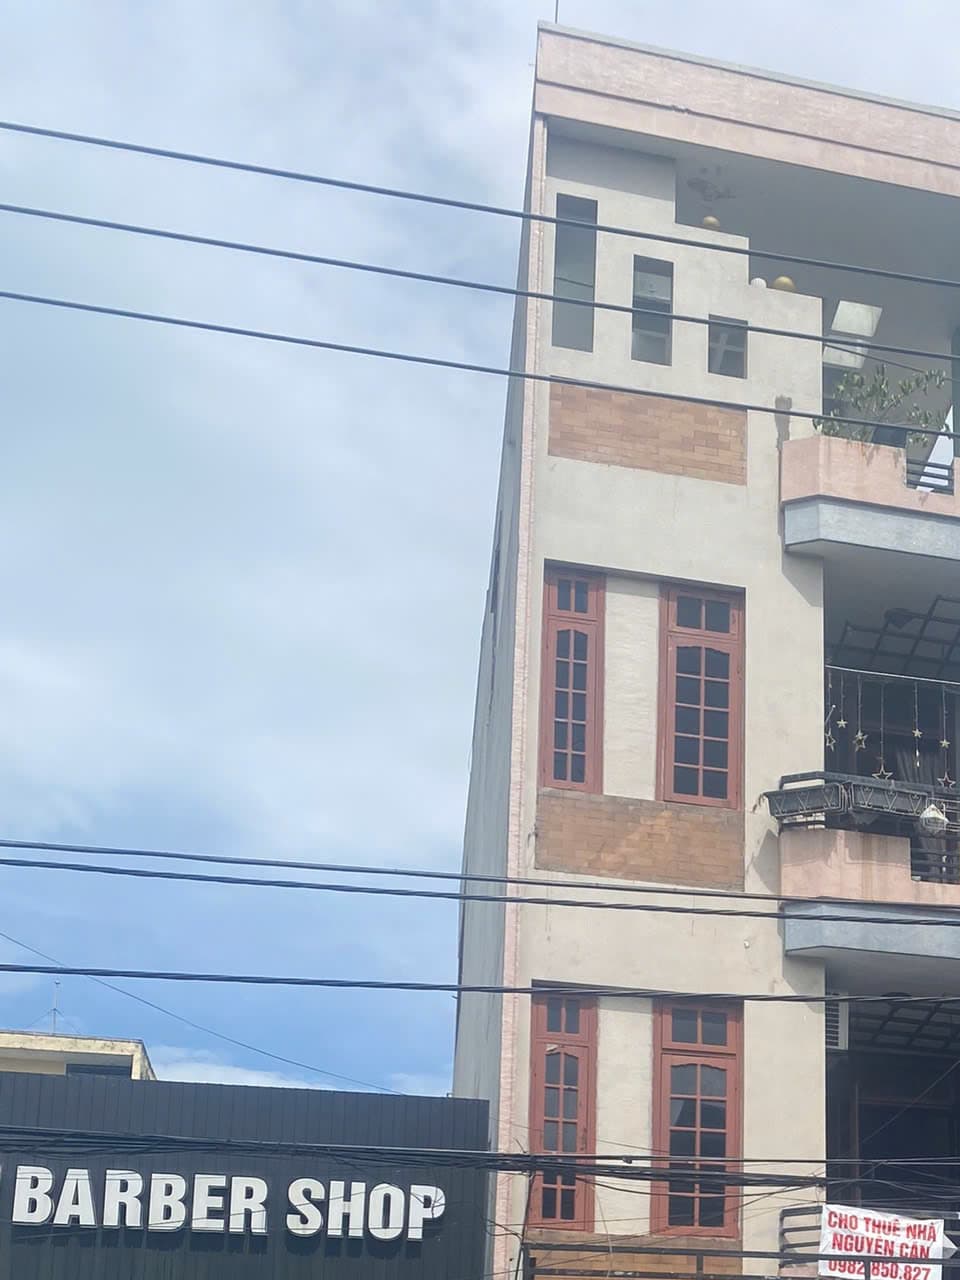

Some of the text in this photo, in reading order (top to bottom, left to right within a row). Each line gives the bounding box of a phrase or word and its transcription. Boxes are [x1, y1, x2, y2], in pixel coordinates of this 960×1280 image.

[11, 1165, 446, 1241] BARBER SHOP
[827, 1210, 858, 1230] CHO
[863, 1217, 901, 1237] THUÊ
